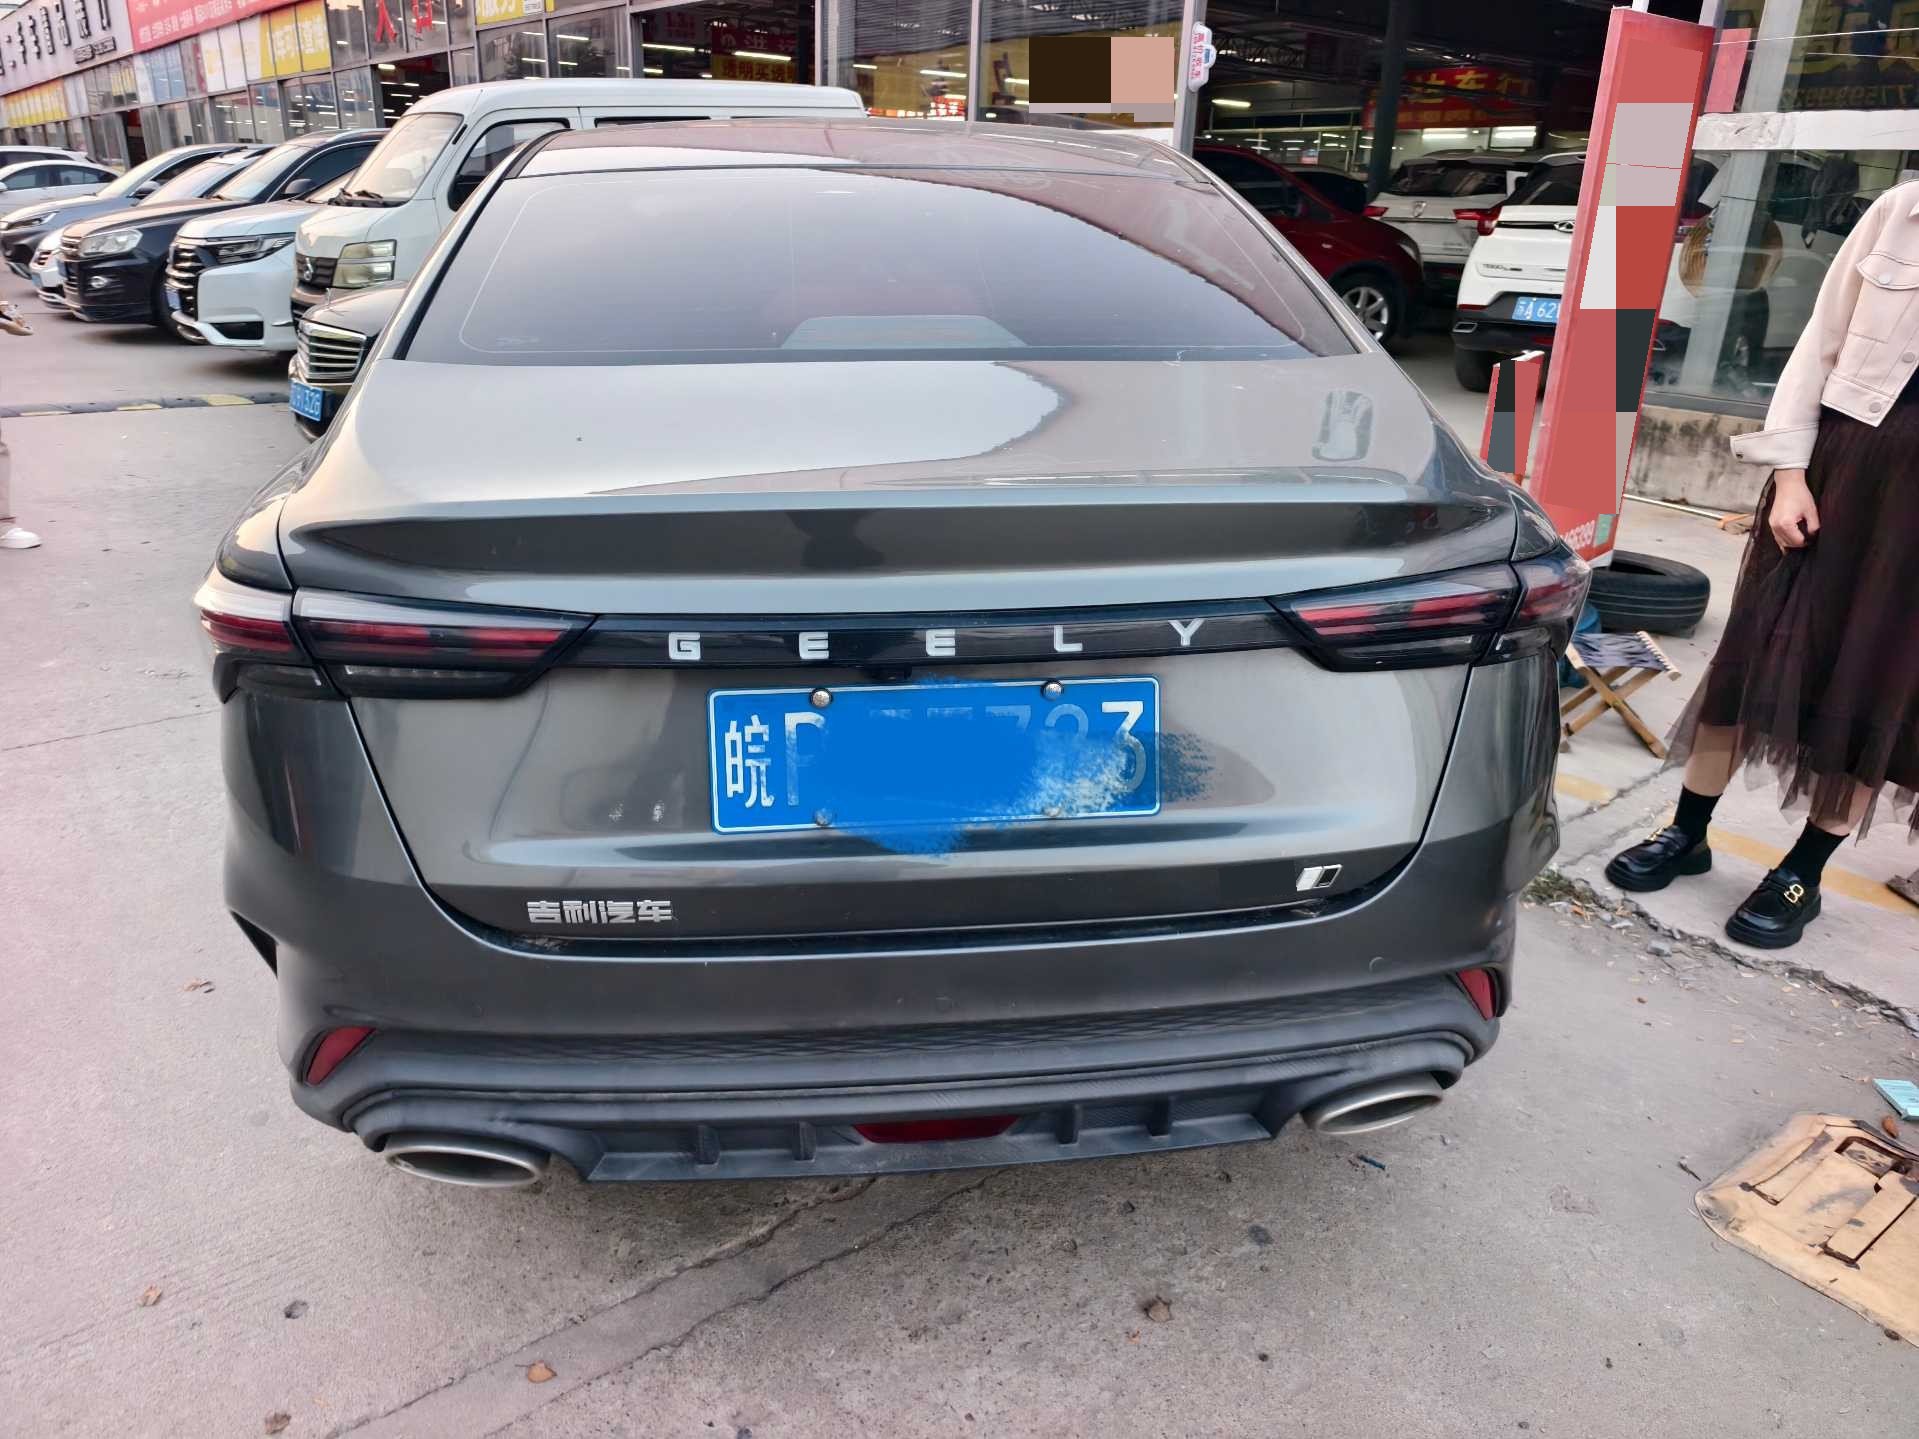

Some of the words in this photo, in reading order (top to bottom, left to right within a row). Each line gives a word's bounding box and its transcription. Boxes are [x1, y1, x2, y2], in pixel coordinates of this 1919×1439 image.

[668, 618, 1206, 661] GEELY
[526, 899, 673, 924] 吉利汽车
